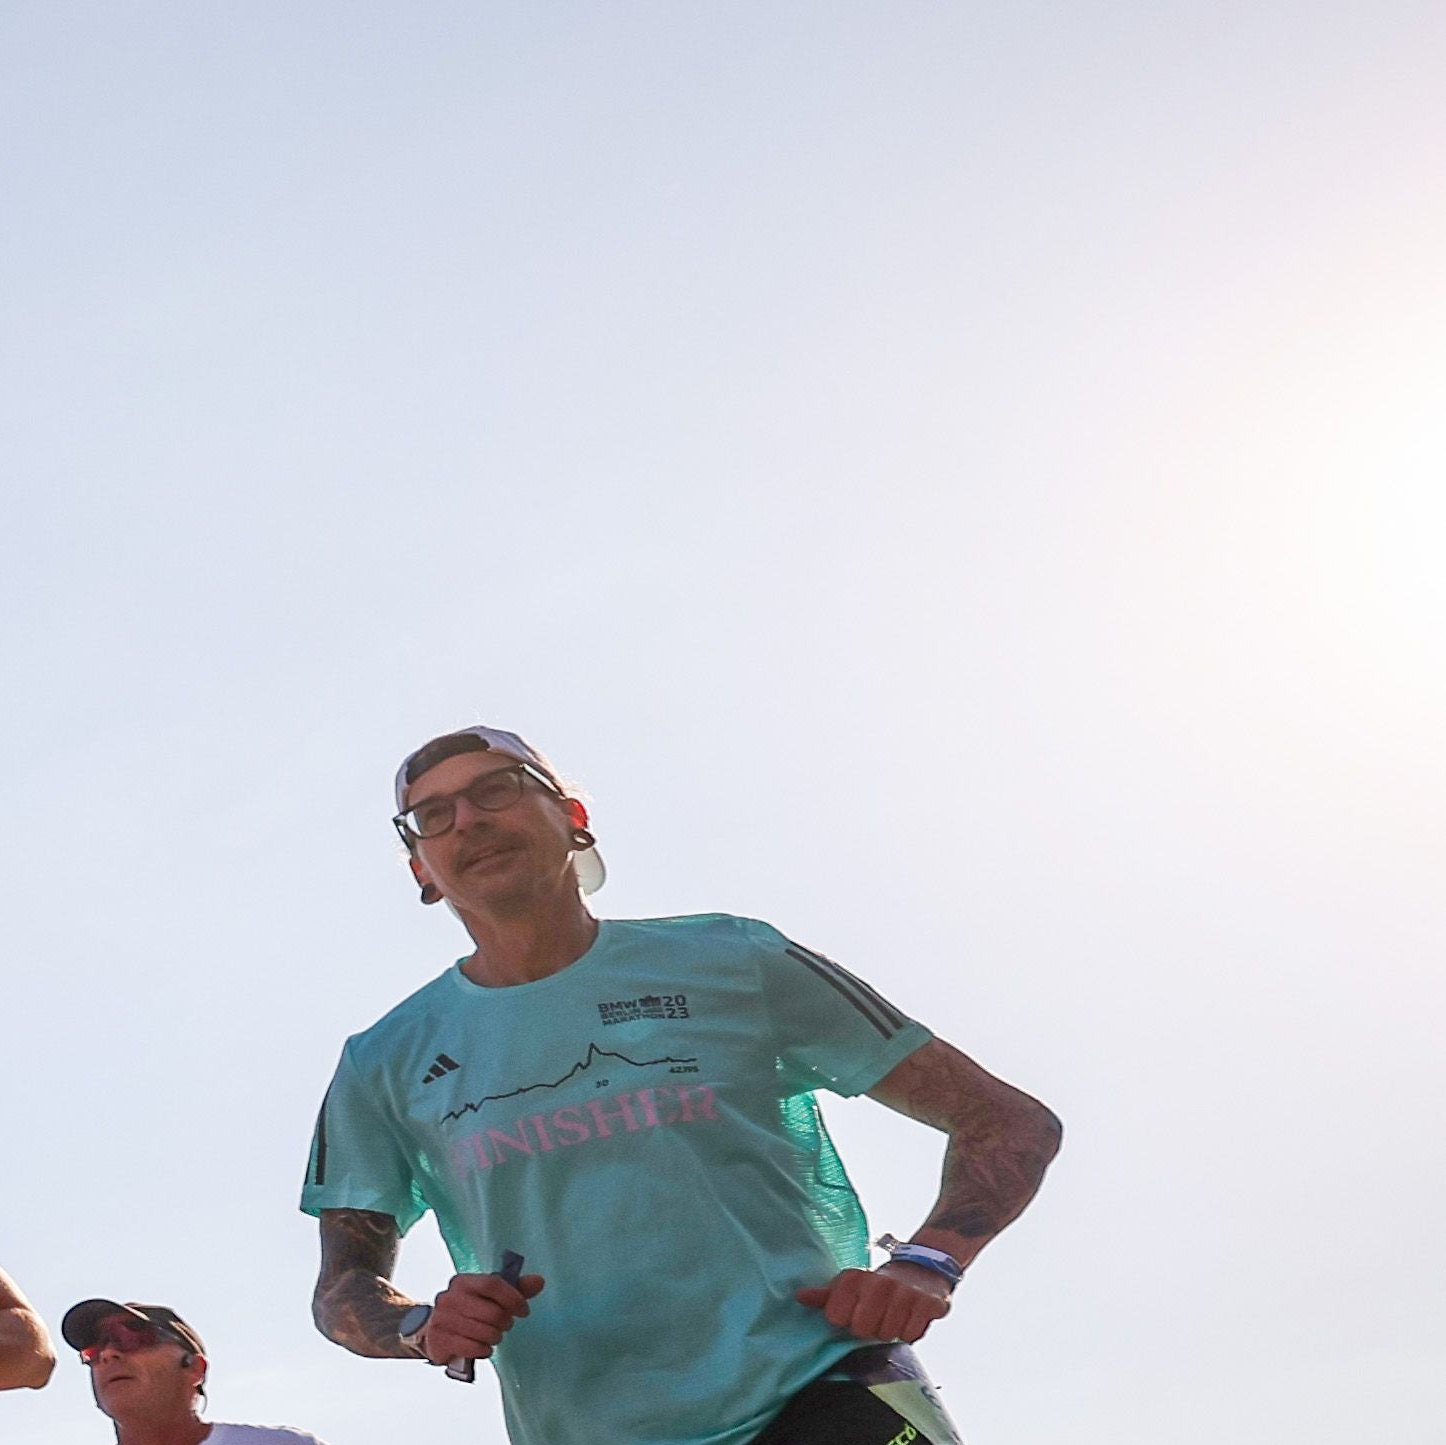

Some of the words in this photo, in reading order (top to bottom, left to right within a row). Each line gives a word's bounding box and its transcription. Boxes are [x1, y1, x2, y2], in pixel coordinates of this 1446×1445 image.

[598, 999, 637, 1013] BMW
[663, 995, 686, 1007] 20
[666, 1008, 689, 1019] 23
[448, 1083, 719, 1181] FINISHER
